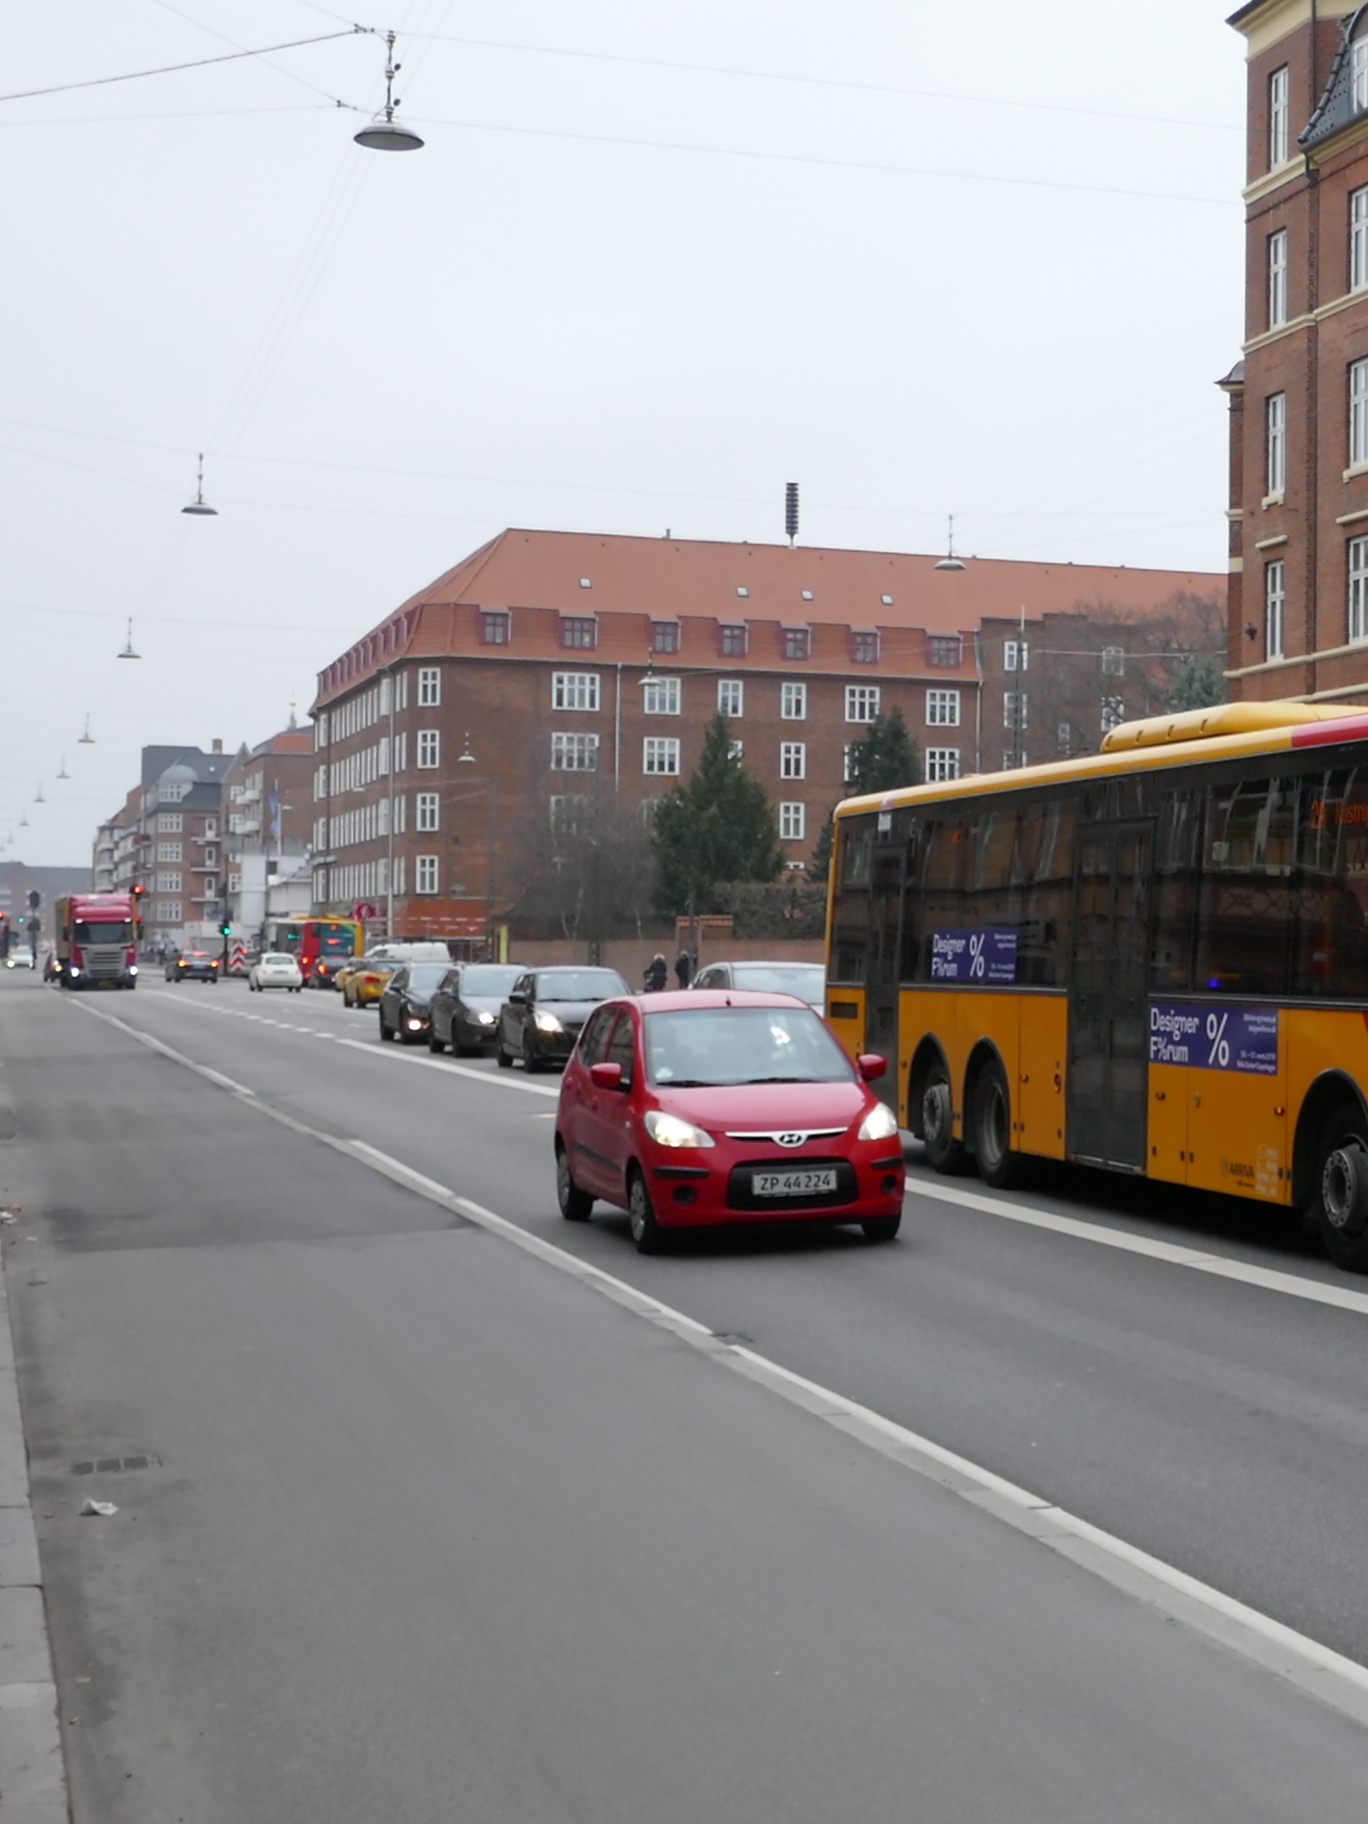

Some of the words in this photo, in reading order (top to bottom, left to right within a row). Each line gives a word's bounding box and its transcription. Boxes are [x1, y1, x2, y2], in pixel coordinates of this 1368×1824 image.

[933, 934, 966, 960] Designer
[1150, 1007, 1199, 1041] Designer
[760, 1177, 779, 1191] ZP
[783, 1176, 802, 1189] 44
[804, 1174, 831, 1189] 224
